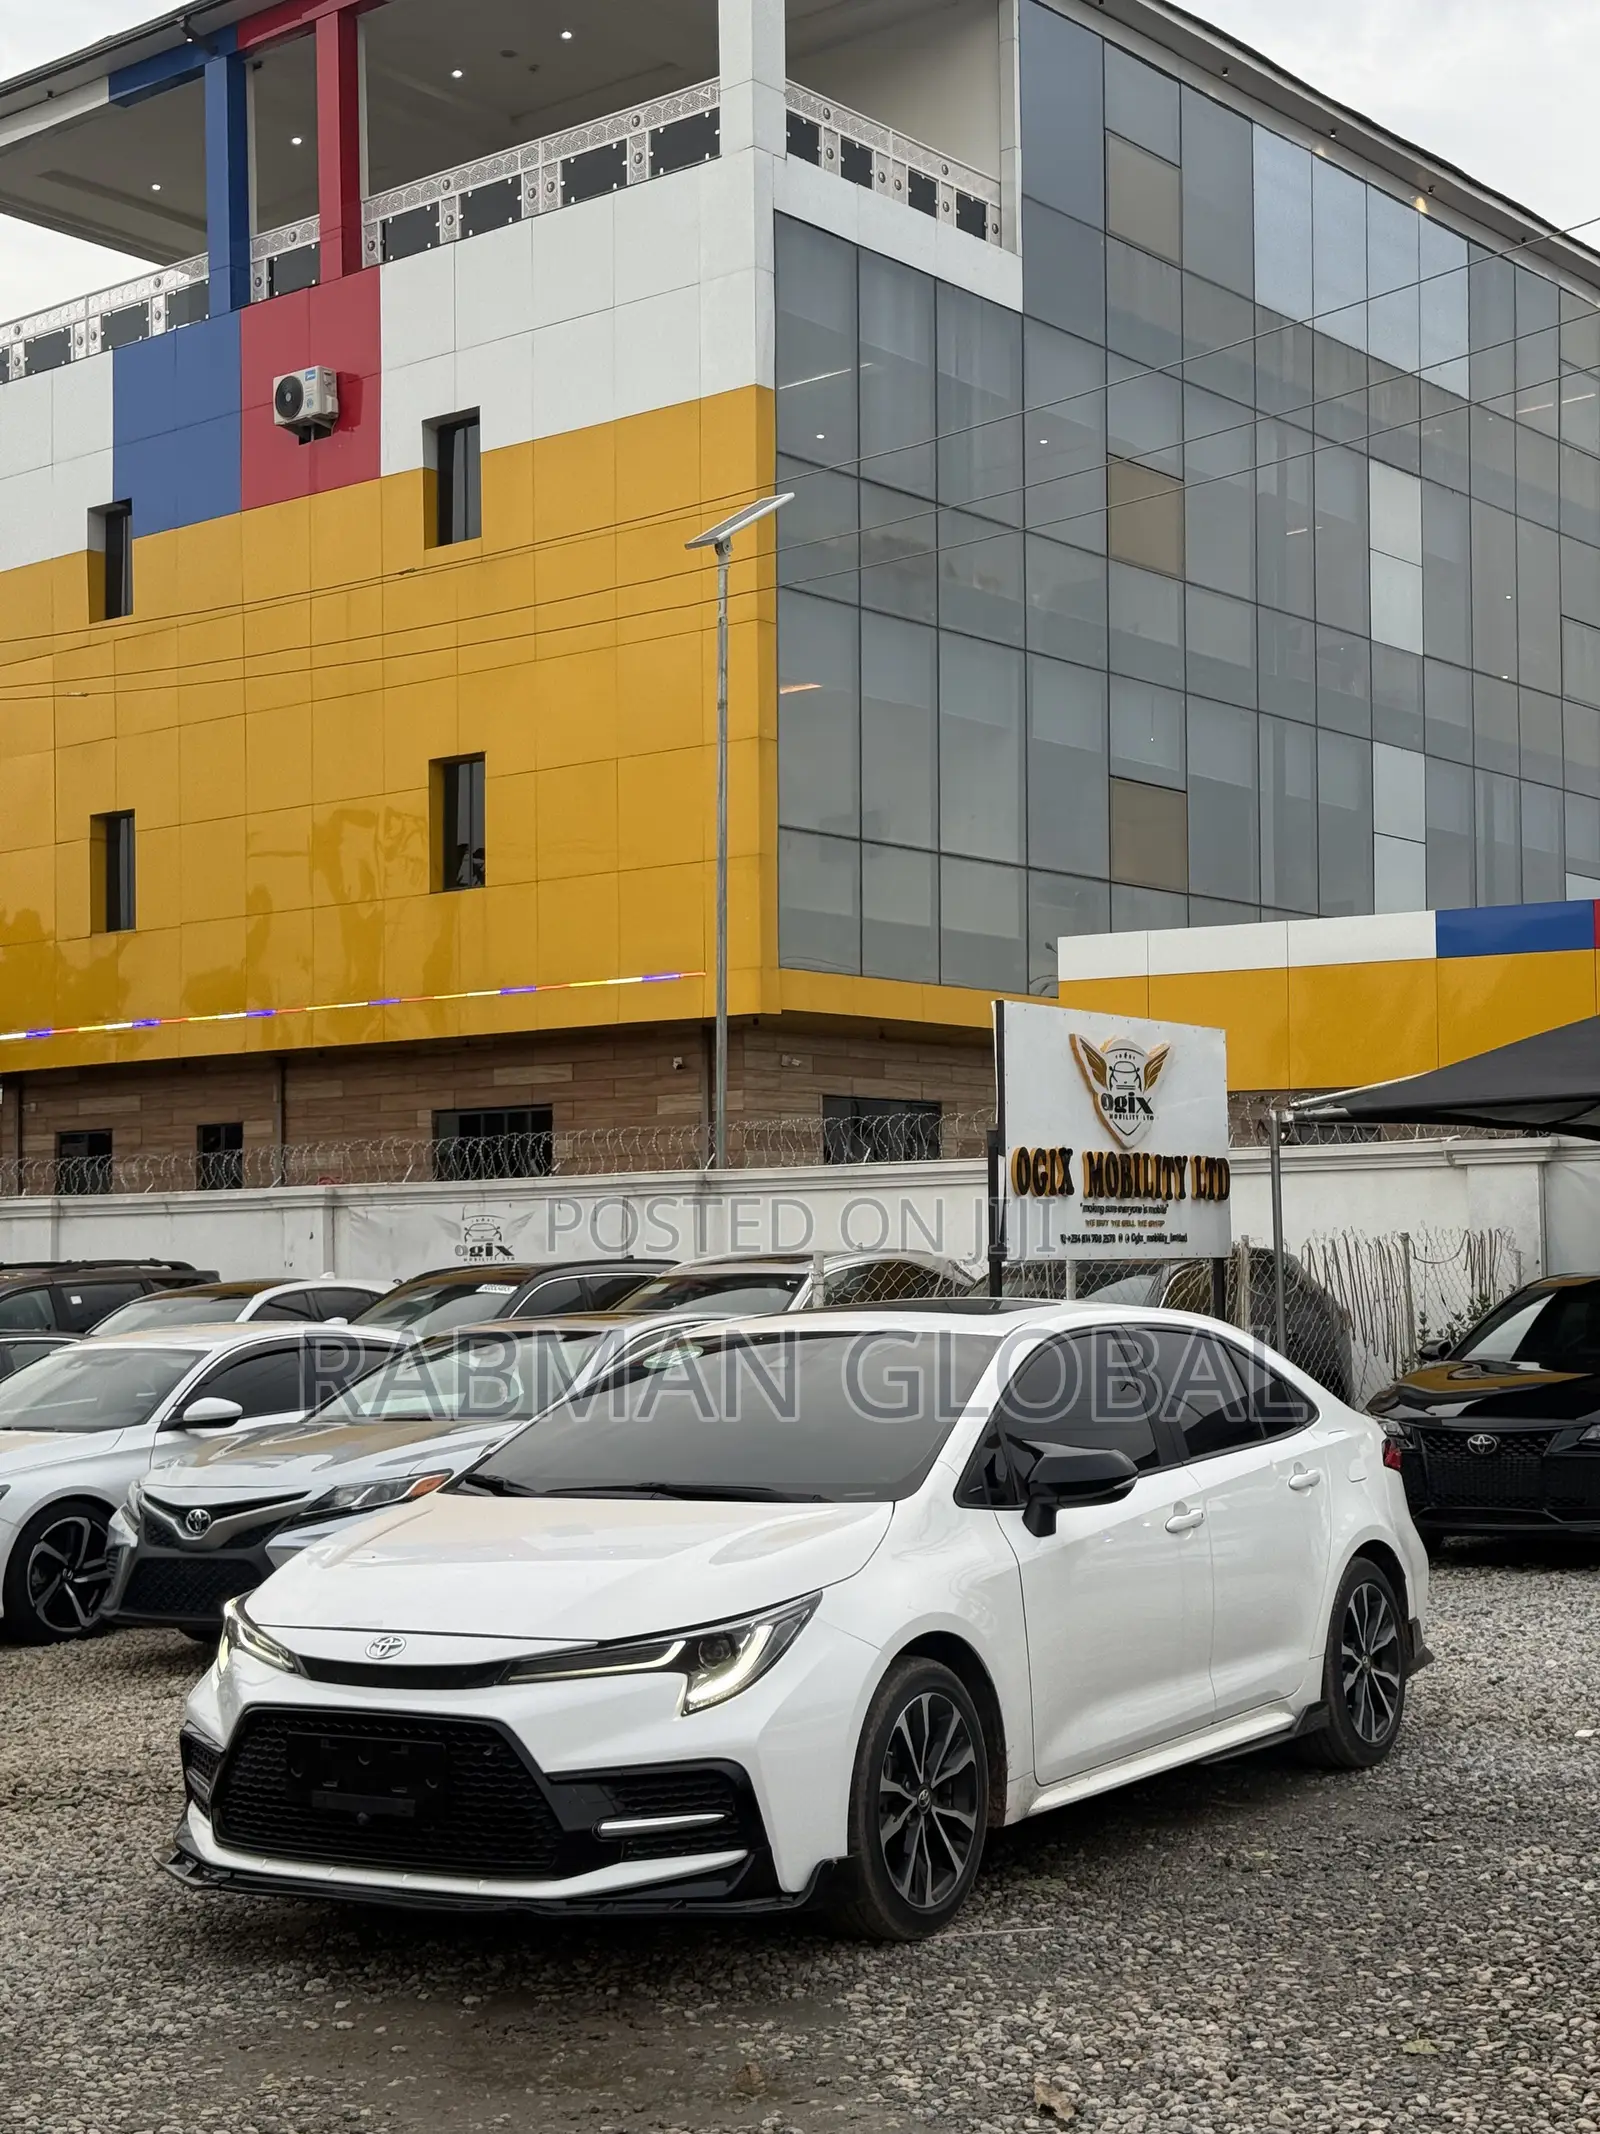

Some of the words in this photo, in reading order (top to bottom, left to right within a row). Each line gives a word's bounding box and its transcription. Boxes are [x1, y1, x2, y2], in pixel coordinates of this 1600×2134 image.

[1109, 1113, 1139, 1121] MOBILITY
[1011, 1147, 1075, 1197] OGIX
[1083, 1151, 1188, 1199] MOBILITY
[1190, 1155, 1230, 1201] LTD
